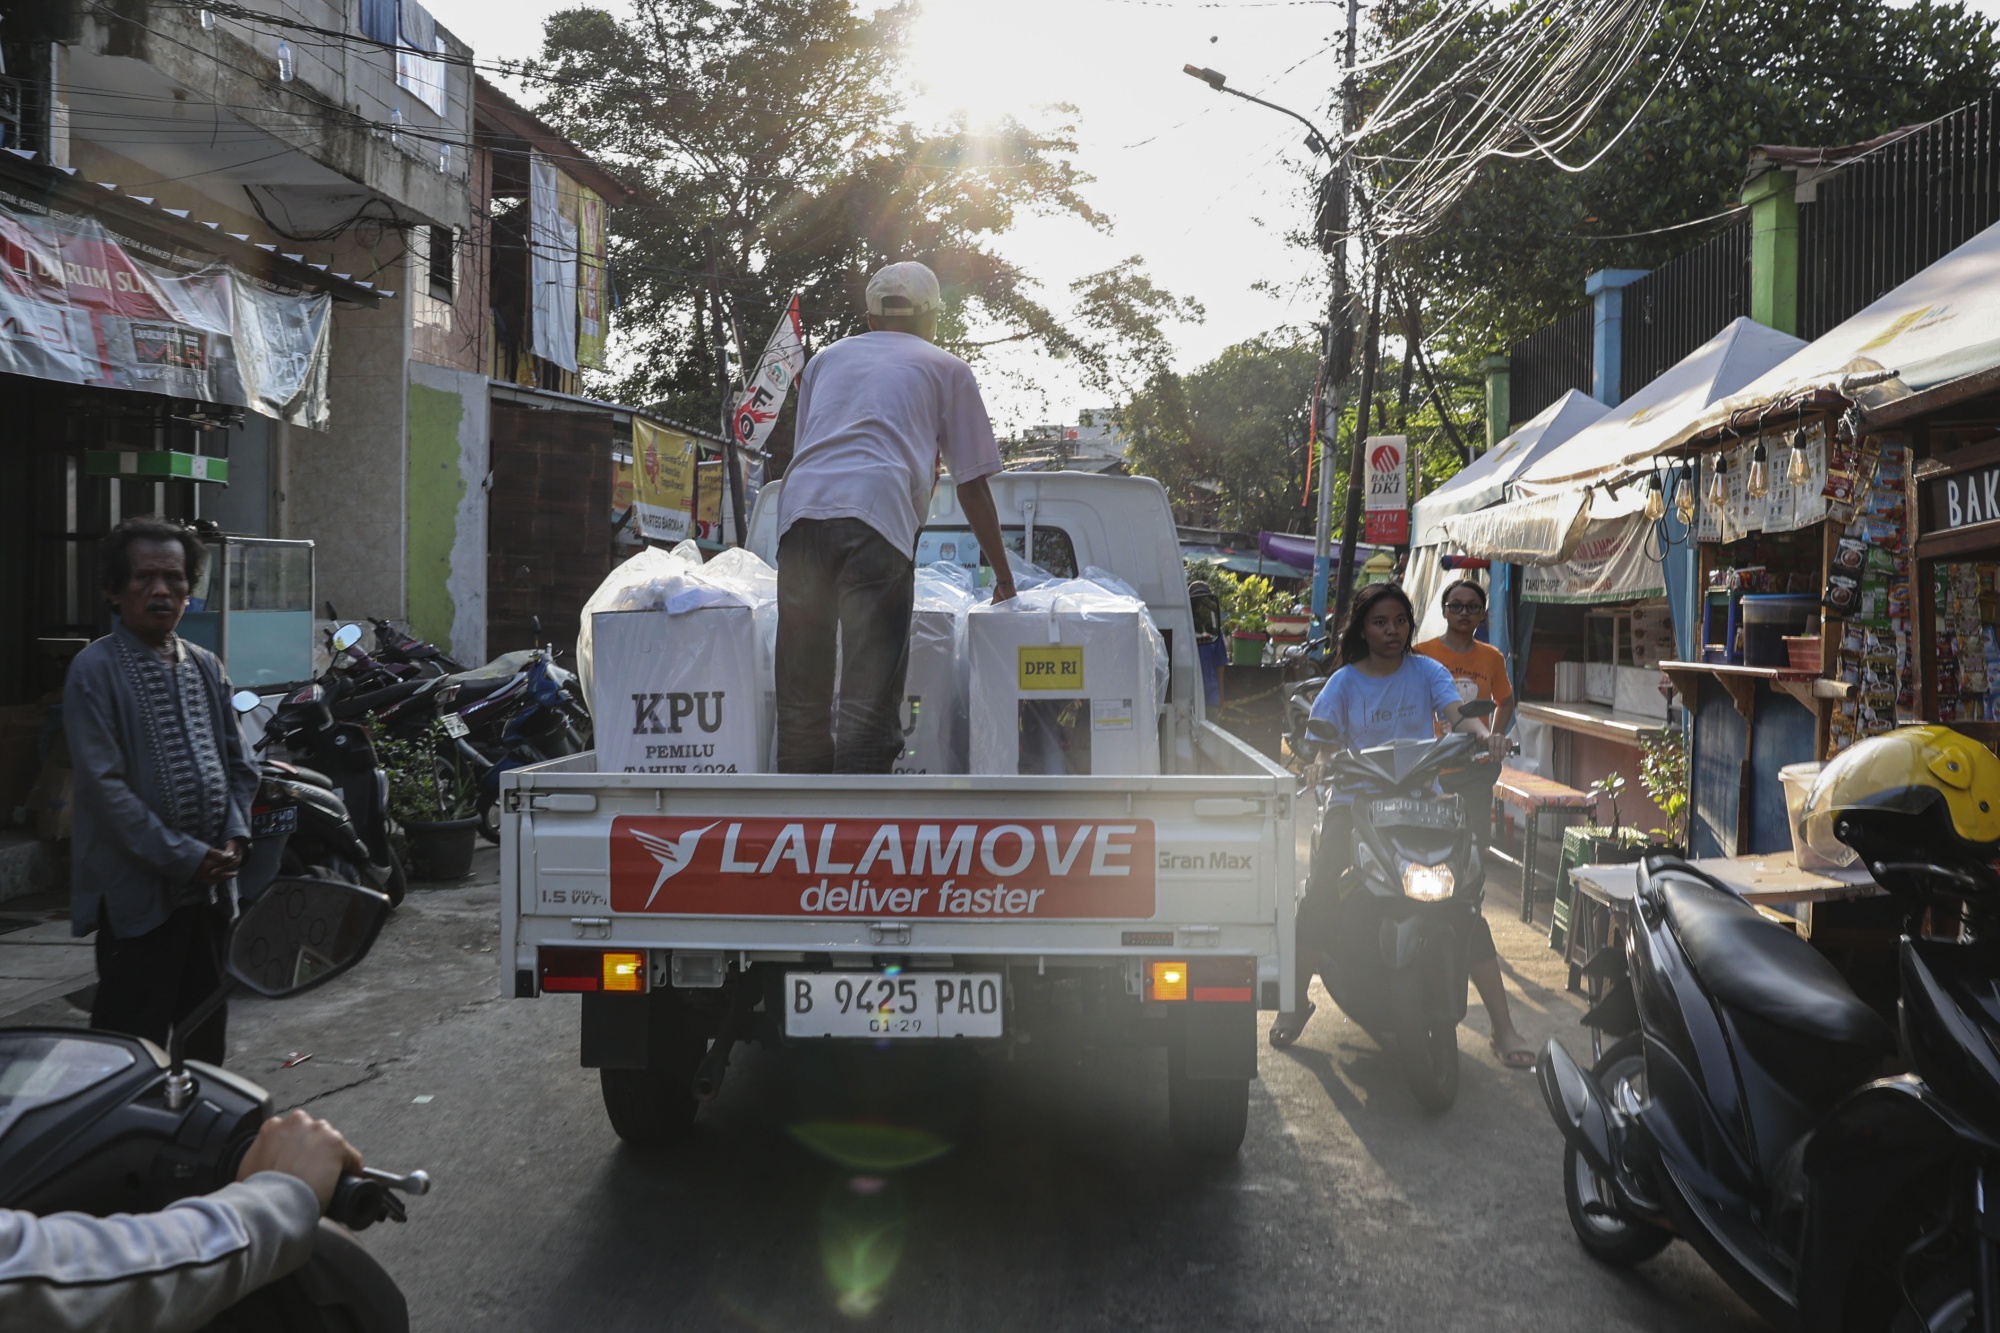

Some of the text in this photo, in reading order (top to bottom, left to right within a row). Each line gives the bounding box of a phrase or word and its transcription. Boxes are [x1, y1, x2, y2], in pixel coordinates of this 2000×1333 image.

[1371, 473, 1401, 483] BANK
[1371, 482, 1401, 495] DKI
[1024, 660, 1077, 675] DPR RI
[631, 691, 725, 735] KPU
[645, 744, 715, 759] PEMILU
[720, 822, 1137, 877] LALAMOVE
[1159, 851, 1252, 869] Gran Max
[542, 889, 567, 904] 1.5
[800, 878, 1045, 914] deliver faster
[793, 978, 998, 1015] B 9425 PAO
